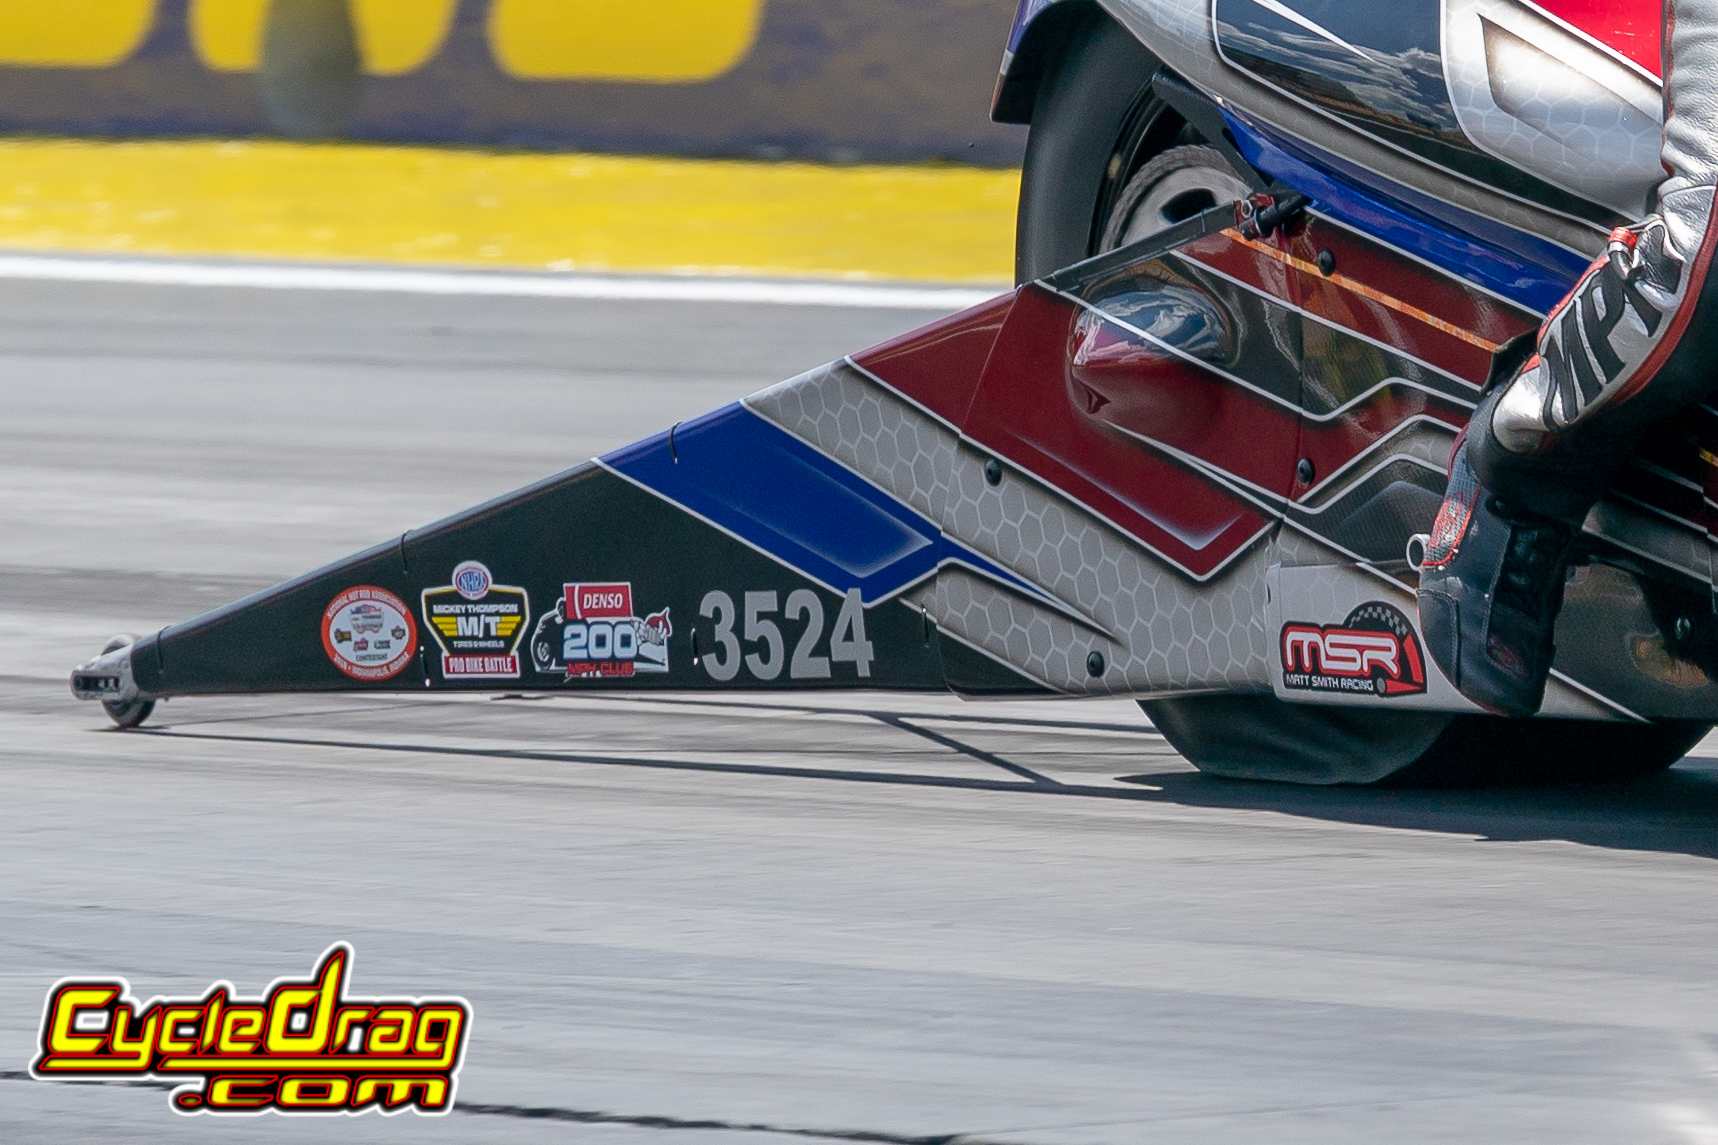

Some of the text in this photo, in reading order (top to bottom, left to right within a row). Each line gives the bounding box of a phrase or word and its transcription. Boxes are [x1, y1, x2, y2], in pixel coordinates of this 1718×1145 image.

[460, 571, 486, 592] NHRA
[433, 603, 518, 614] MICKEY THOMPSON
[583, 592, 623, 609] DENSO
[457, 614, 500, 638] M/T
[699, 587, 875, 681] 3524
[563, 623, 637, 660] 200
[1285, 630, 1398, 675] MSR
[449, 656, 513, 673] PRO BIKE BATTLE
[600, 661, 634, 674] CLUB
[1286, 674, 1374, 691] MATT SMITH RACING
